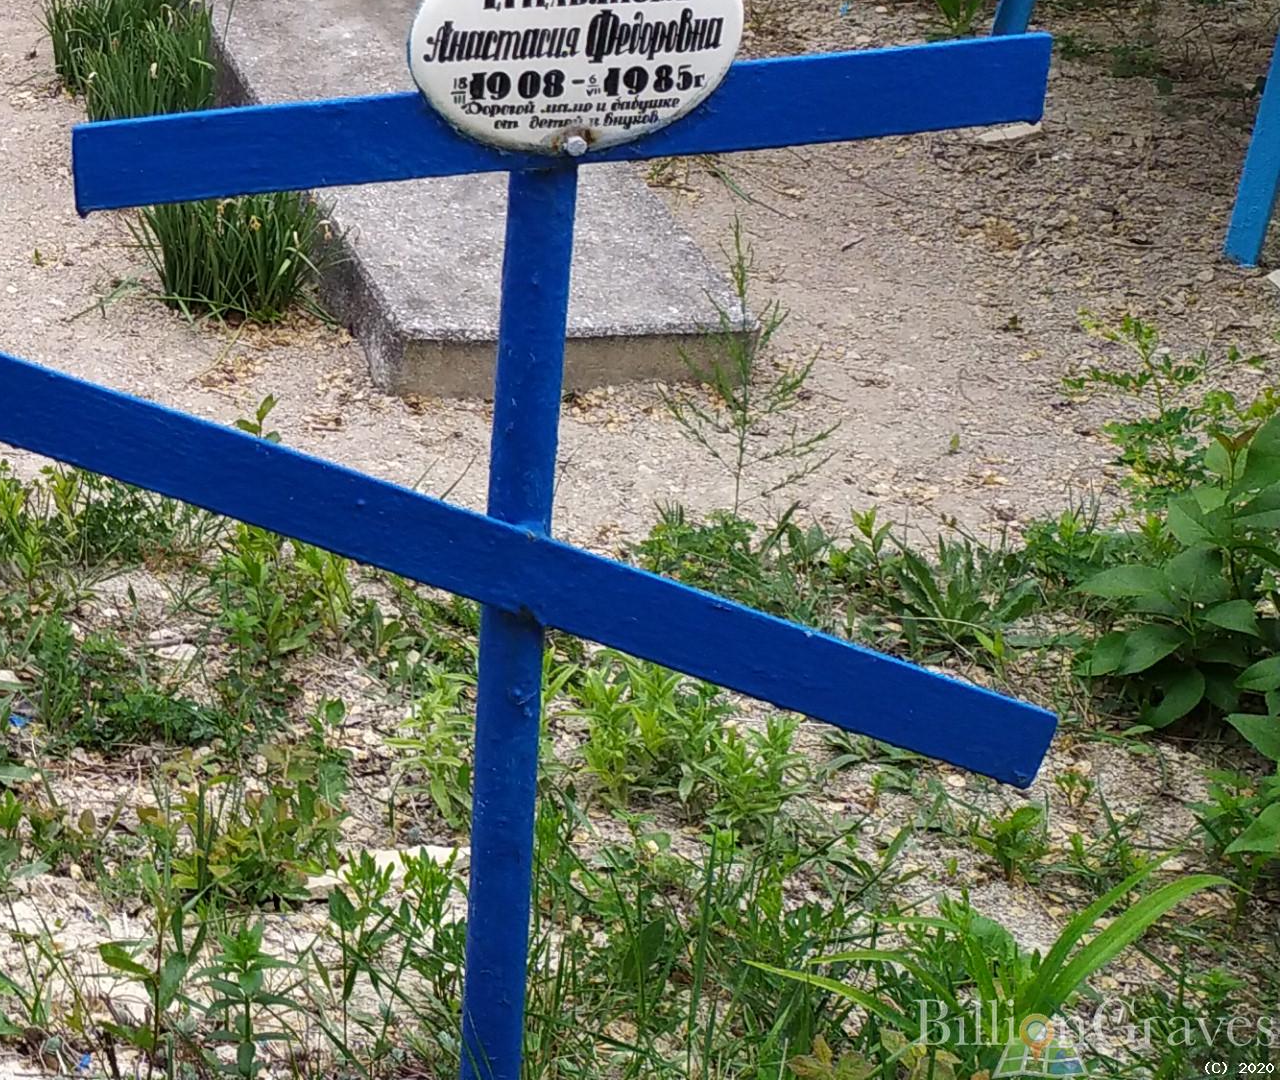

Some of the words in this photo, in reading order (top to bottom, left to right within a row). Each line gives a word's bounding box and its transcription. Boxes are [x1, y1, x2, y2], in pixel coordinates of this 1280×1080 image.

[423, 20, 580, 63] Анастасия
[585, 8, 724, 64] Федоровна
[469, 69, 565, 100] 1908
[461, 100, 535, 118] Дорогой
[596, 102, 607, 112] и
[611, 95, 680, 113] бабушке
[493, 119, 519, 130] от
[602, 110, 659, 130] внуков
